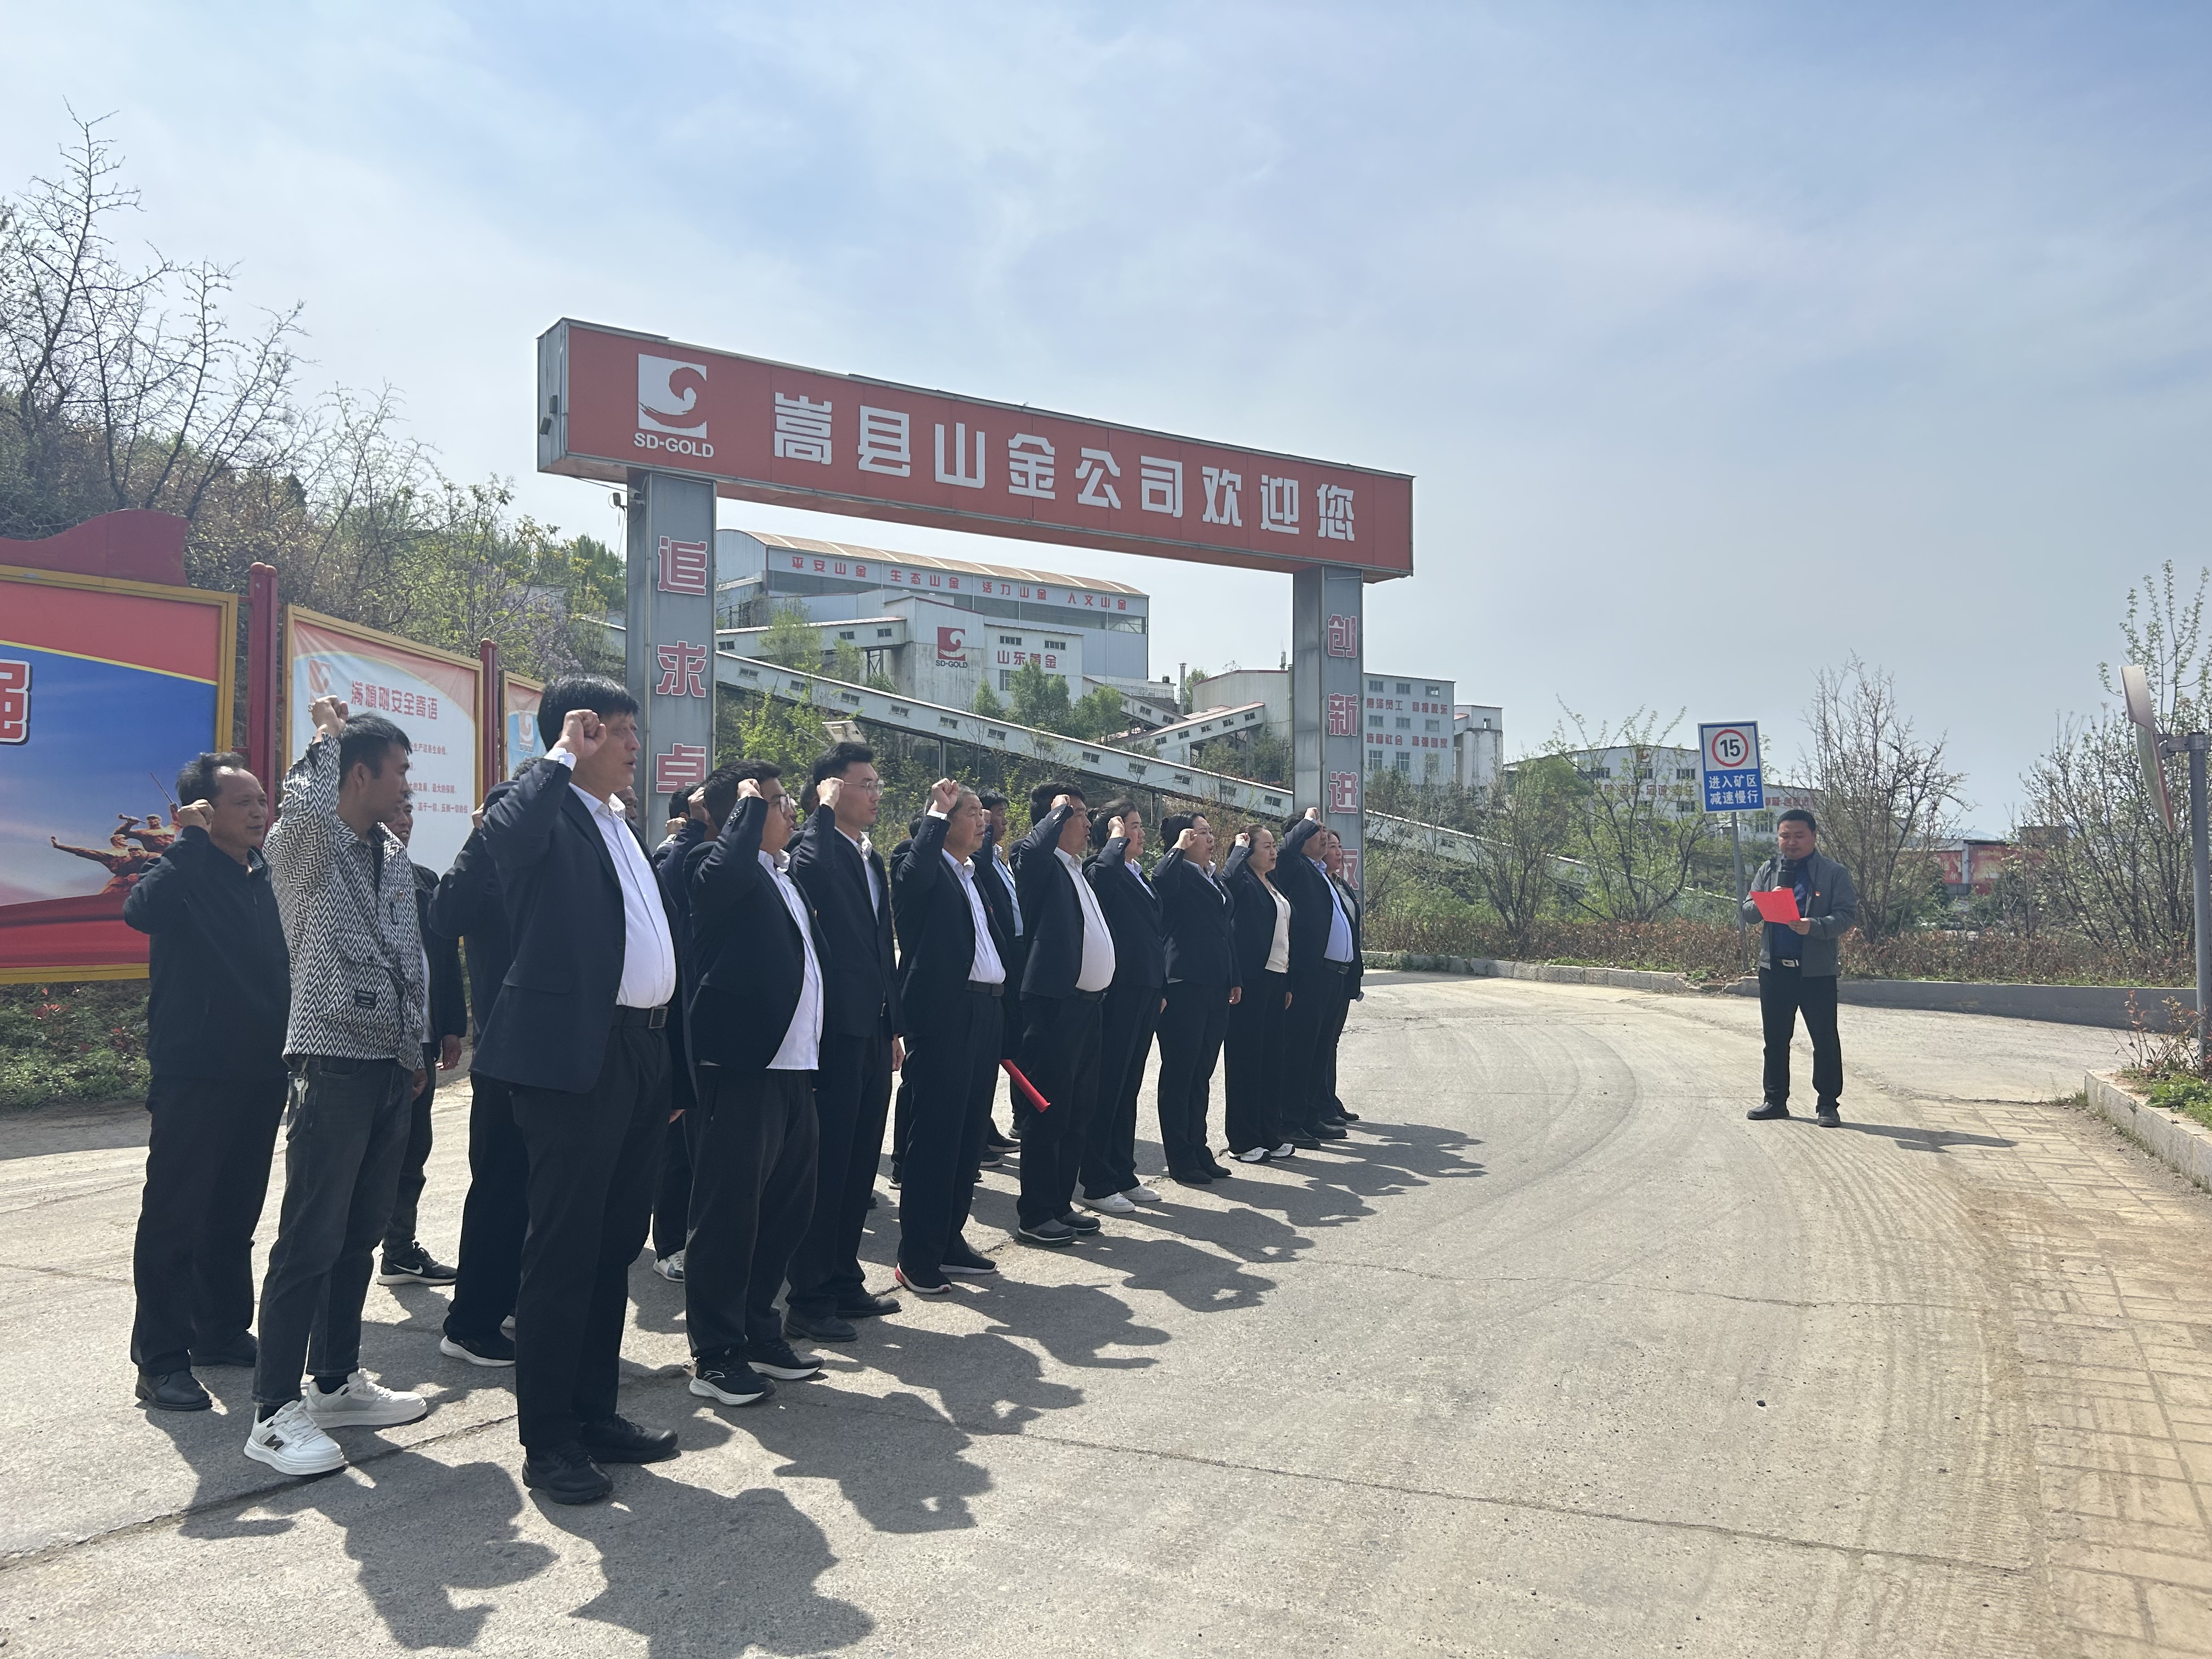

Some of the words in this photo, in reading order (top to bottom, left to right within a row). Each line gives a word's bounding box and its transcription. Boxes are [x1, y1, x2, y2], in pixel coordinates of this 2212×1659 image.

[633, 432, 714, 458] SD-GOLD
[774, 392, 1356, 543] 嵩县山金公司欢迎您
[792, 556, 866, 578] 平安山金
[890, 569, 960, 589] 生态山金
[983, 582, 1047, 600] 活力山金
[1068, 592, 1126, 610] 人文山金
[935, 659, 968, 668] SD-GOLD
[997, 650, 1057, 668] 山东黄金
[1412, 701, 1448, 714] 回报股东
[1367, 732, 1403, 745] 造福社会
[1412, 736, 1448, 748] 富强国家
[1720, 739, 1740, 758] 15
[1709, 774, 1757, 789] 进入矿区
[1710, 790, 1758, 805] 减速慢行
